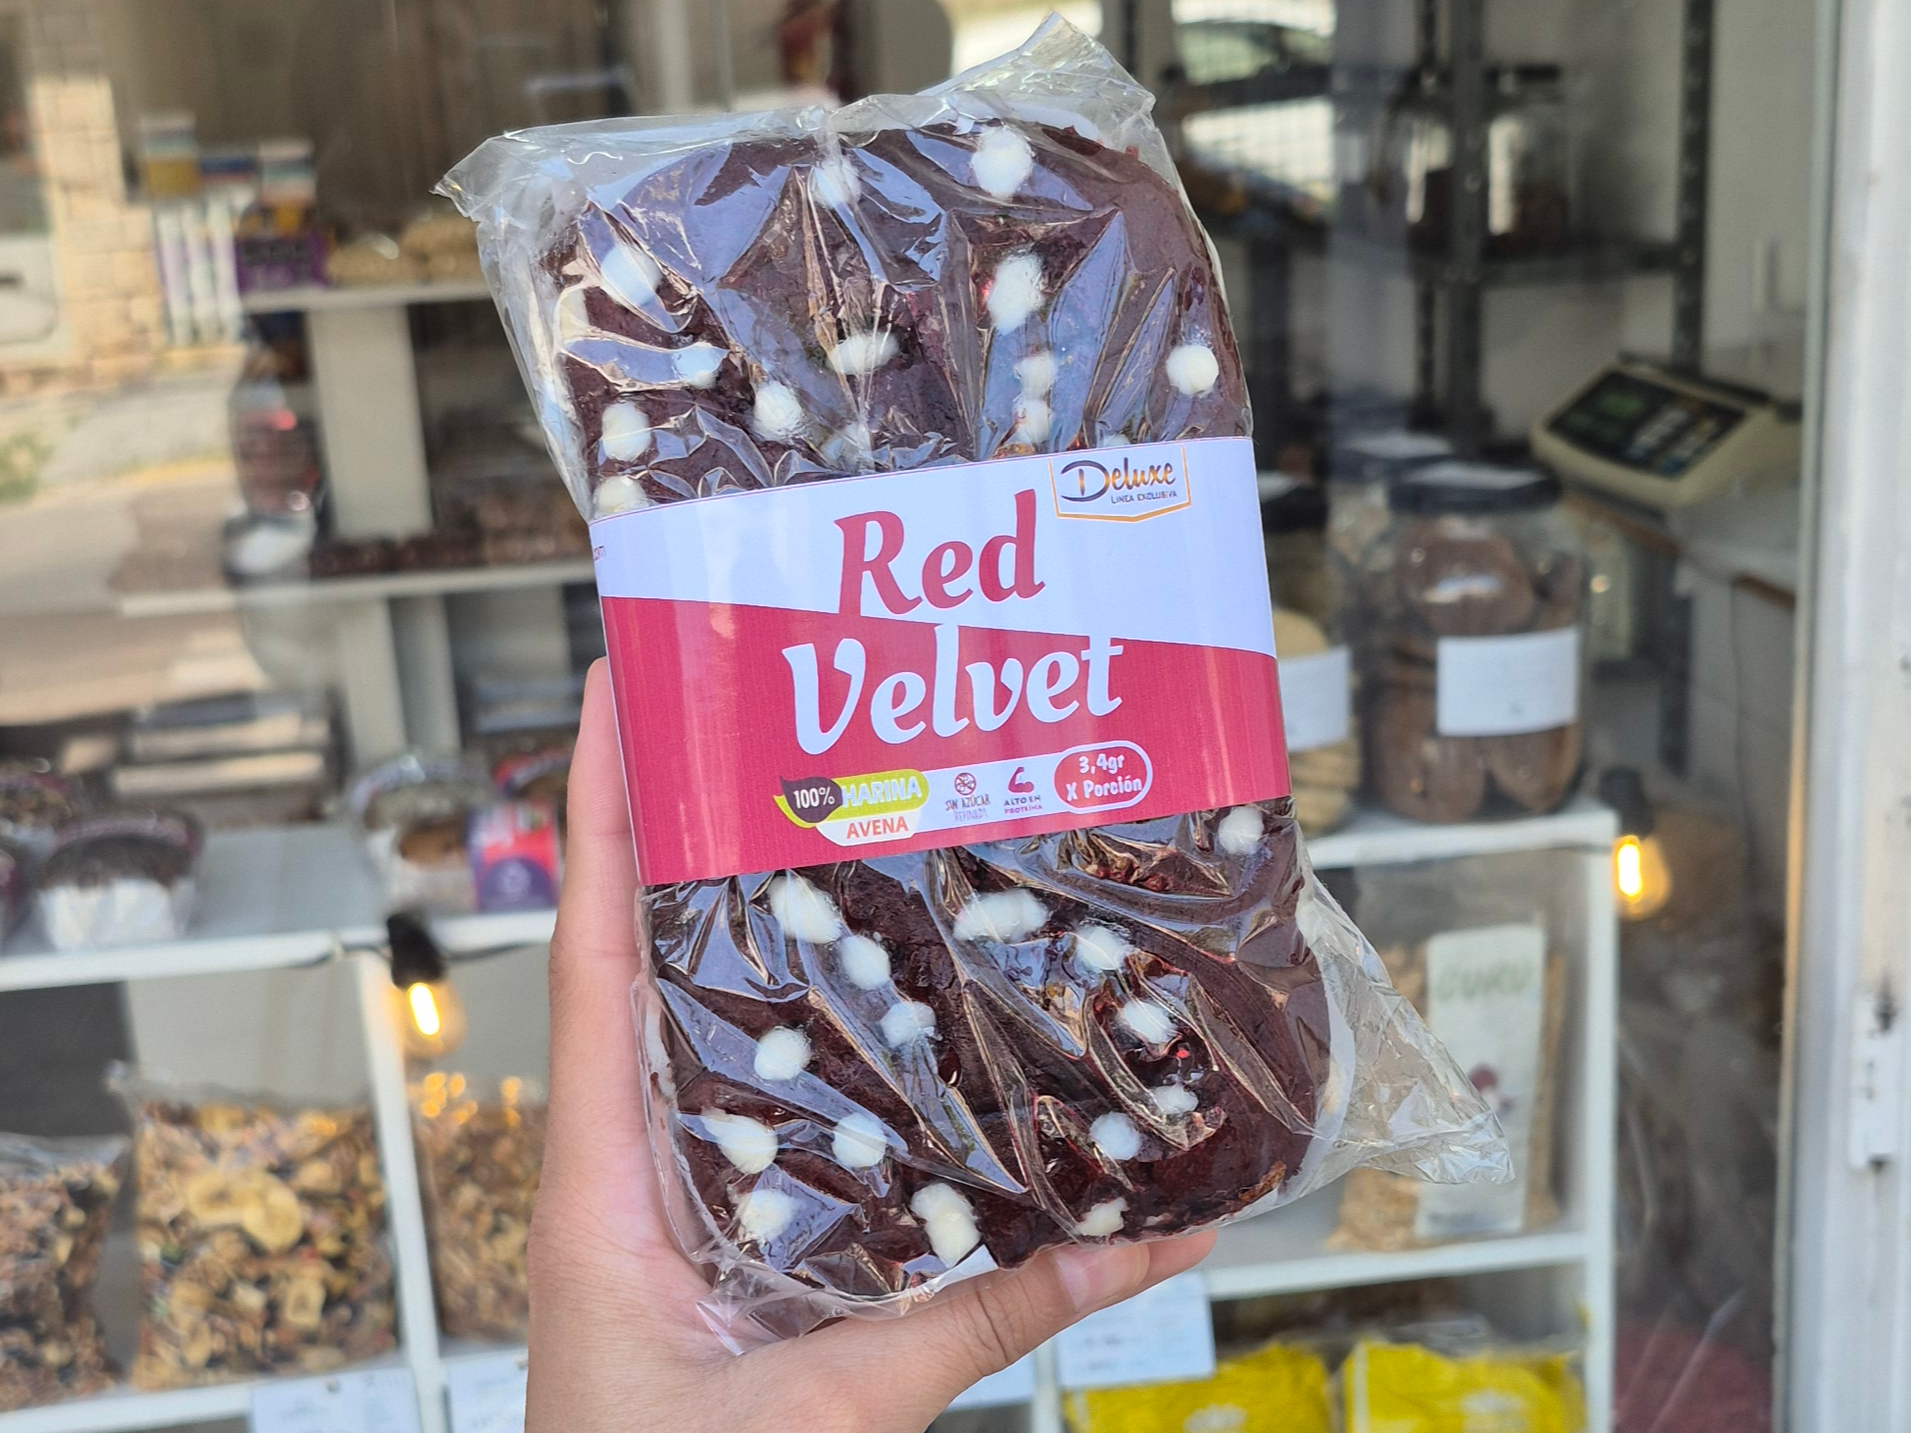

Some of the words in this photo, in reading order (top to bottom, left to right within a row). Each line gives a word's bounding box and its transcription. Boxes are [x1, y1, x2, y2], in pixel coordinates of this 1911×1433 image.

[1060, 456, 1176, 502] Deluxe
[1137, 490, 1178, 501] EXCLUSIVA
[834, 488, 1046, 617] Red
[781, 622, 1125, 756] Velvet
[1078, 753, 1126, 775] 3,4gr
[793, 785, 836, 809] 100%
[841, 776, 923, 808] HARINA
[1003, 796, 1028, 807] ALTO
[1029, 794, 1042, 803] EN
[1066, 783, 1078, 802] X
[1083, 774, 1143, 799] Porción
[945, 799, 959, 812] SIN
[962, 793, 992, 809] AZÚCAR
[846, 815, 909, 840] AVENA
